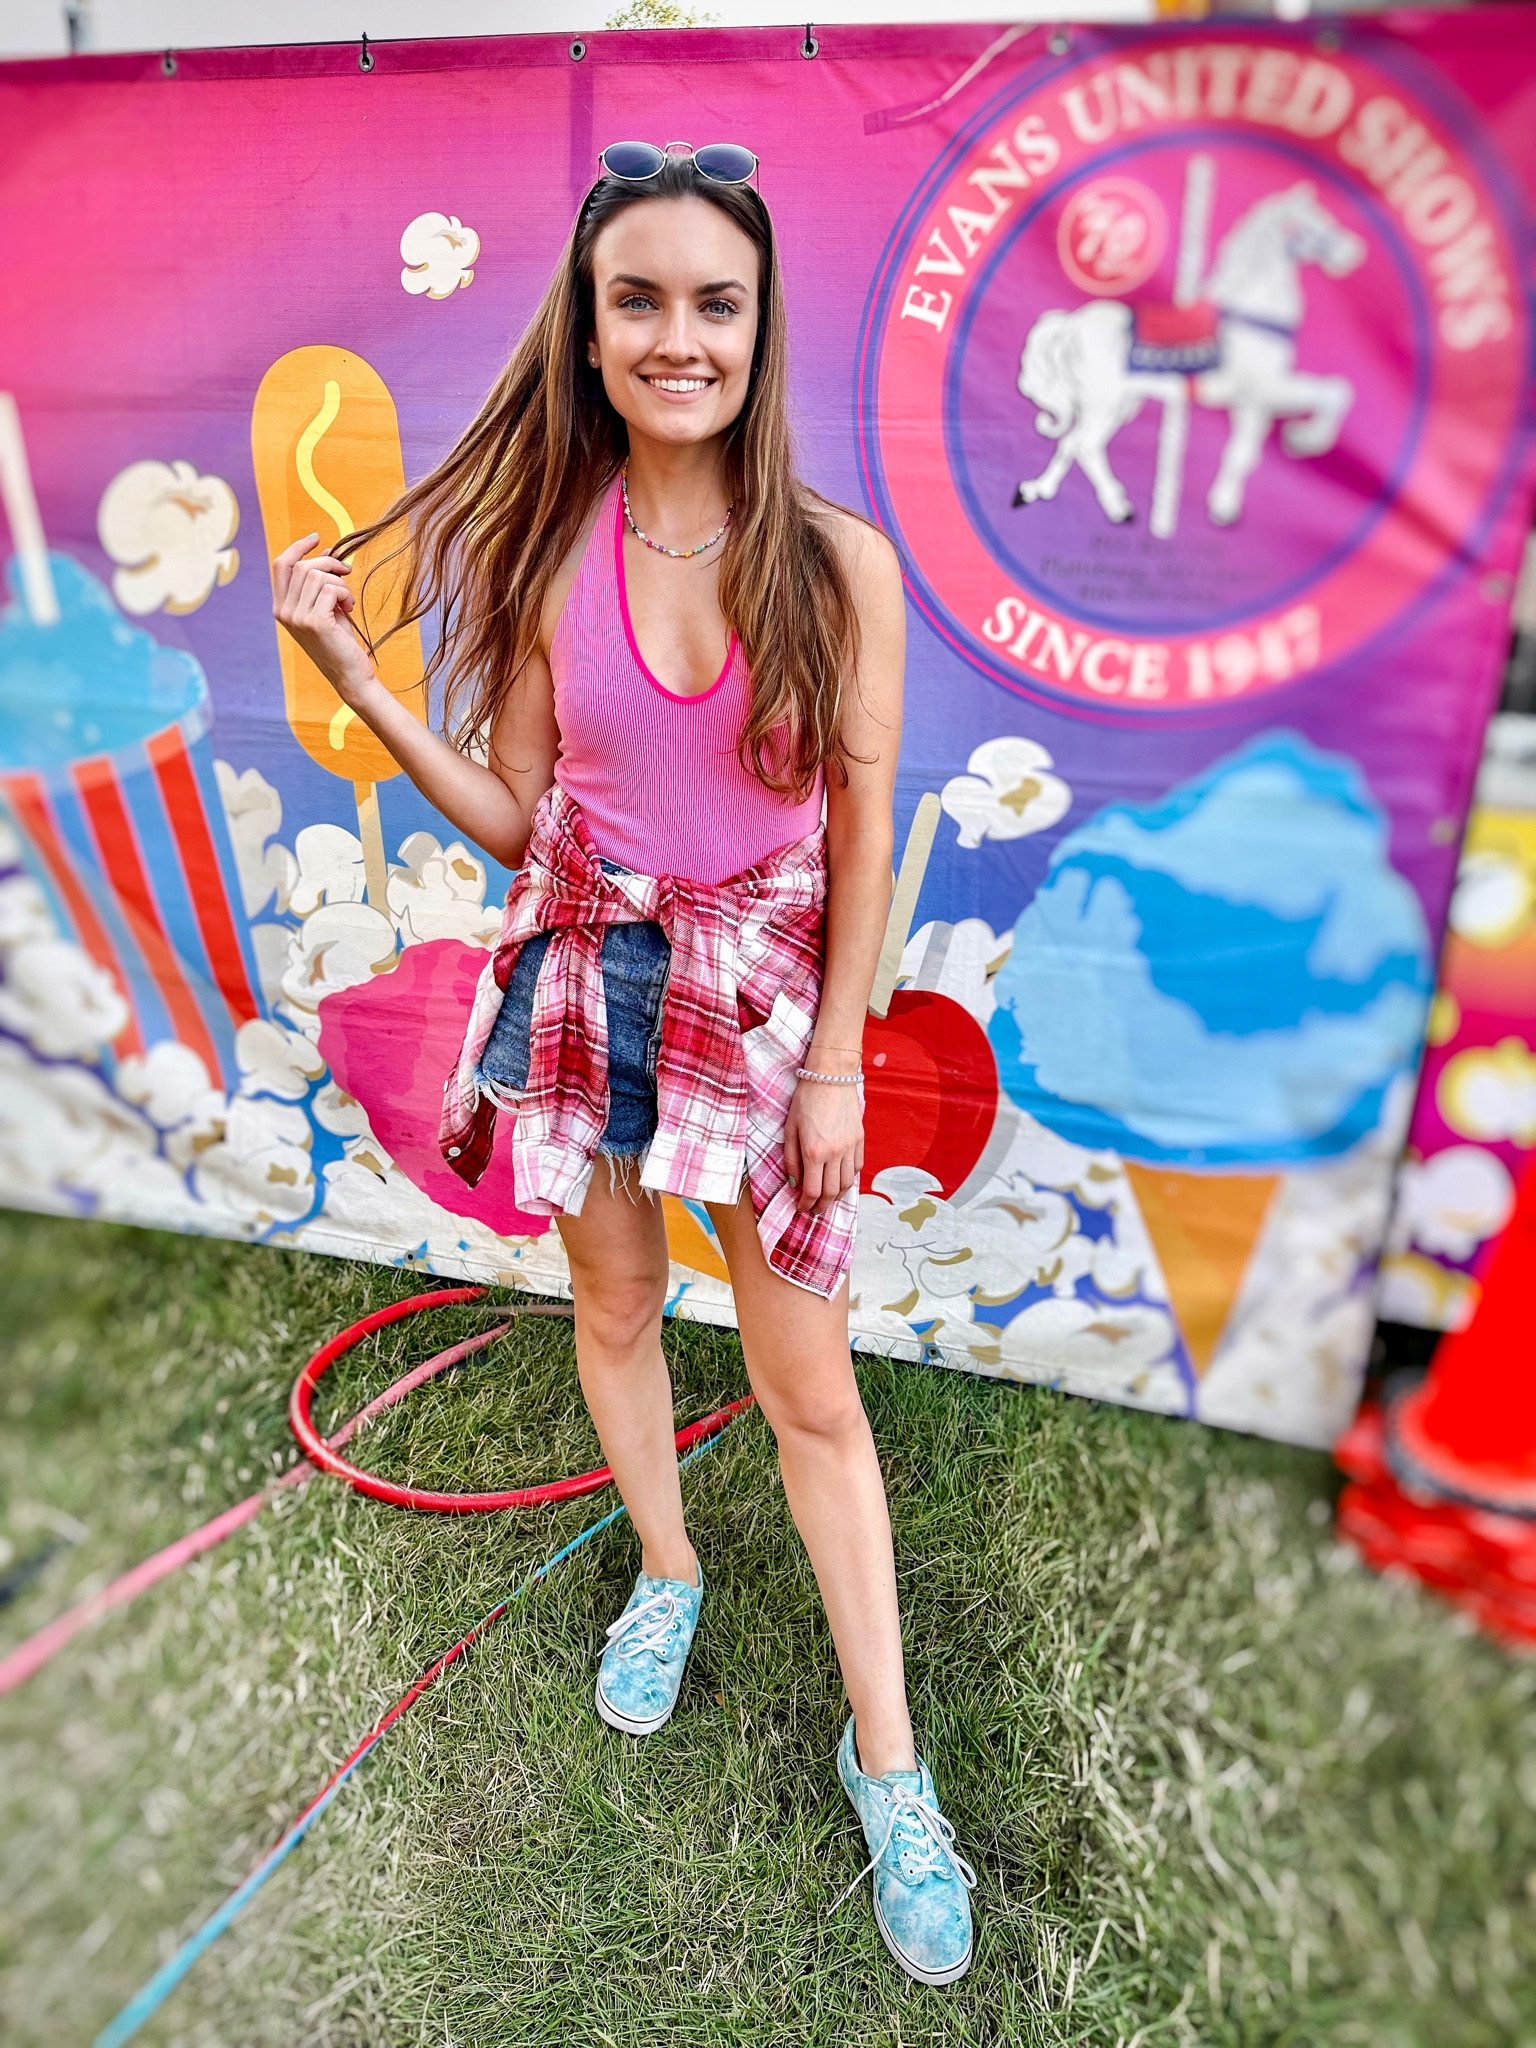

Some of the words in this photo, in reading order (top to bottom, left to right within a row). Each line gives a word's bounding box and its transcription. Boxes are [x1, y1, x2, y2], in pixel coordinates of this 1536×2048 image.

[900, 115, 1061, 333] EVANS
[1061, 44, 1353, 138] UNITED
[1338, 95, 1513, 350] SHOWS
[982, 596, 1170, 699] SINCE
